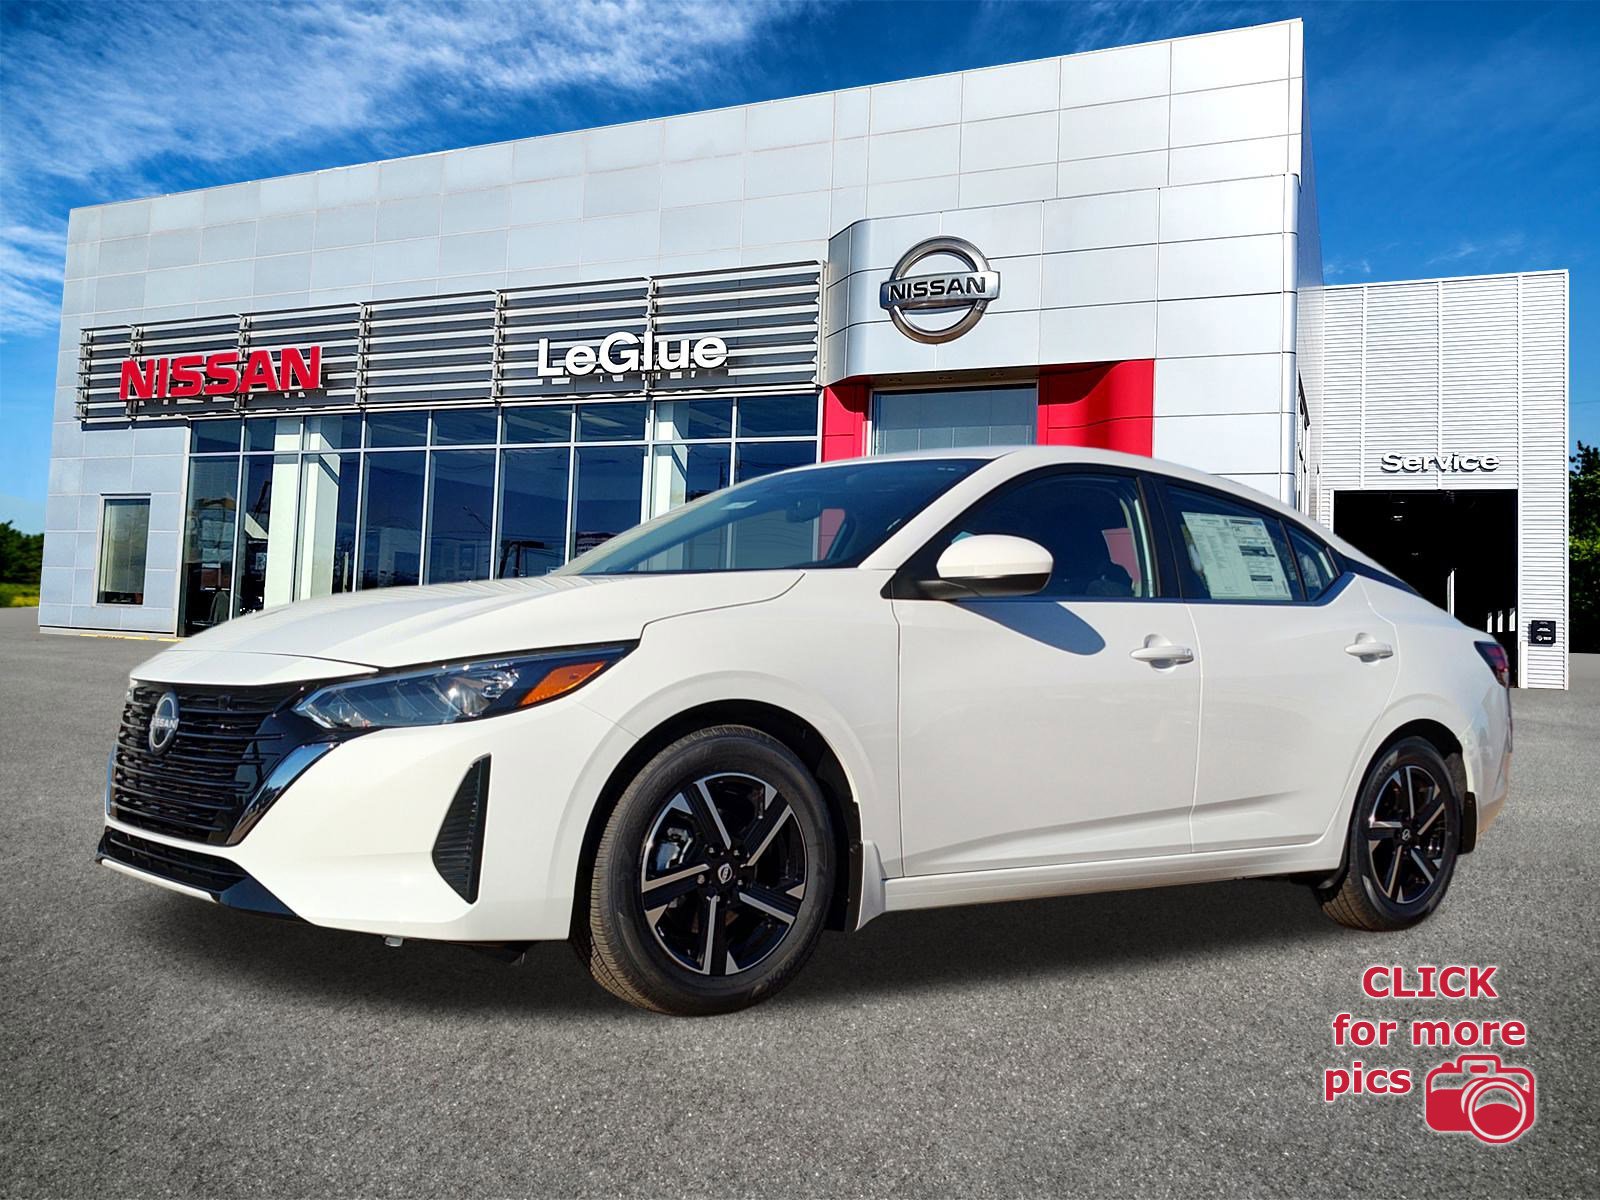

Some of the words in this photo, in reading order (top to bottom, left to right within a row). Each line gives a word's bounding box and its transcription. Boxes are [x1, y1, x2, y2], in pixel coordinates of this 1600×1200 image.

[889, 276, 986, 301] NISSAN
[537, 331, 729, 377] LeGlue
[119, 346, 322, 400] NISSAN
[1381, 450, 1500, 473] Service
